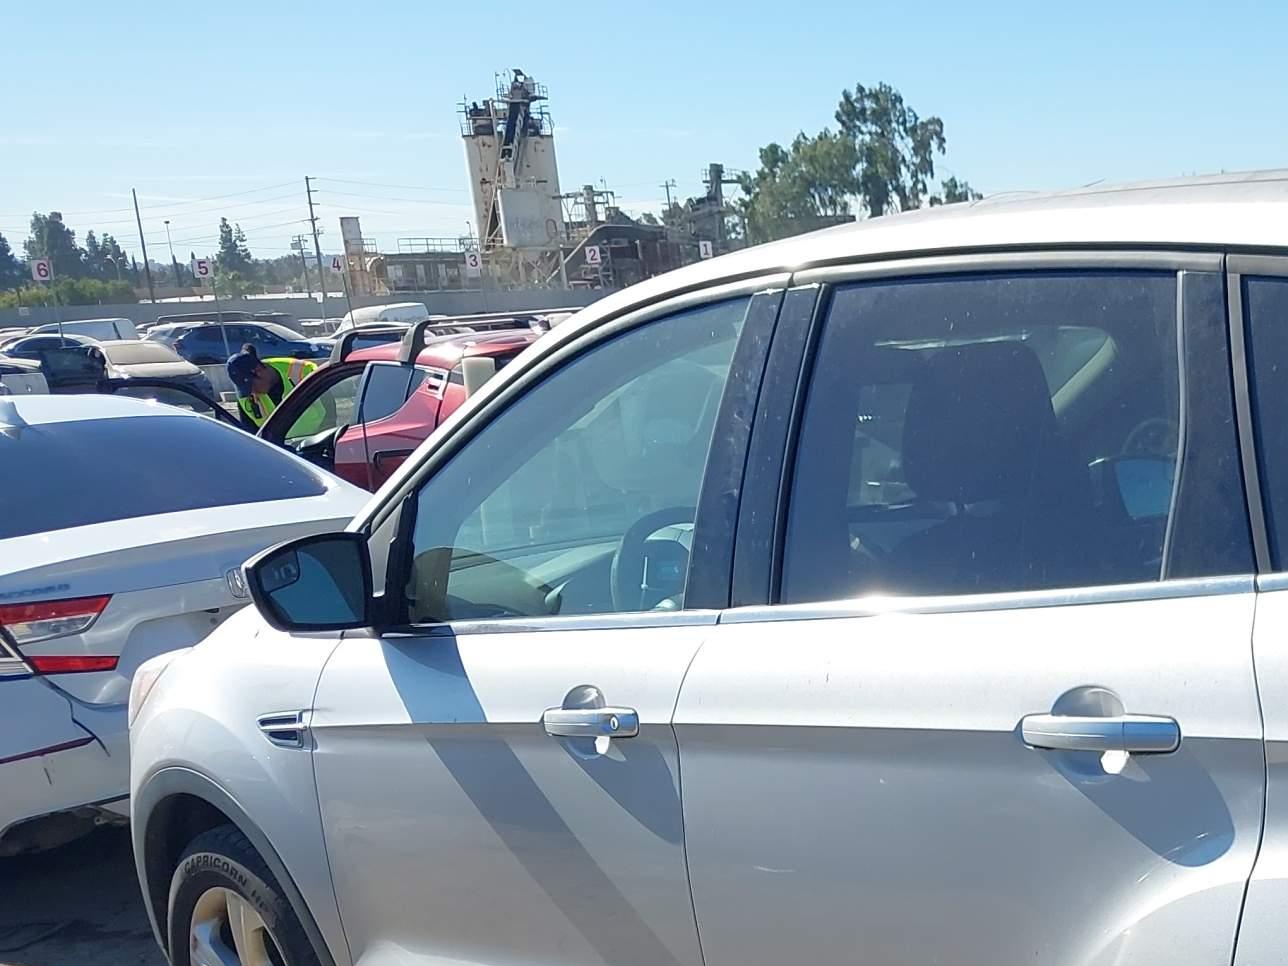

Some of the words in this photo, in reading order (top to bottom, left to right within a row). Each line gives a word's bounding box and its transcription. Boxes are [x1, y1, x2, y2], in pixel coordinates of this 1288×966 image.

[468, 254, 478, 268] 3
[588, 249, 598, 262] 2
[36, 262, 49, 278] 6
[197, 261, 209, 276] 5
[332, 257, 341, 271] 4
[184, 855, 248, 886] CAPRICORN
